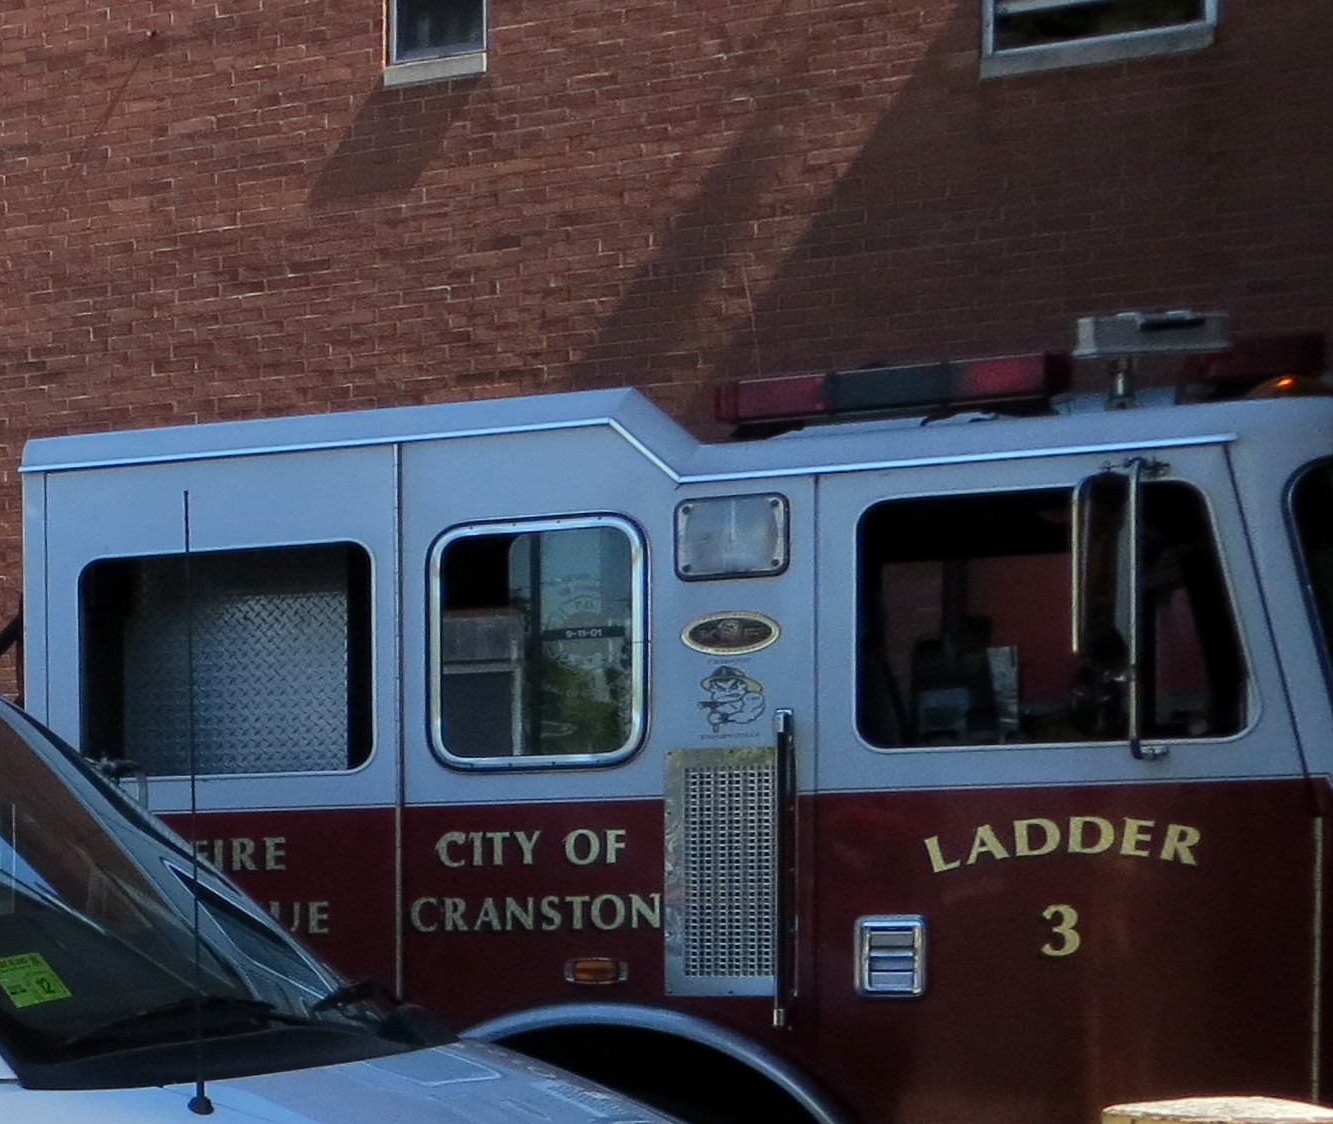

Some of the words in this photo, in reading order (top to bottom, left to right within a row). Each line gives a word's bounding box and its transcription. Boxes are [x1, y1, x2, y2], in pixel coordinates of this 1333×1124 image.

[435, 830, 541, 867] CITY
[564, 829, 626, 865] OF
[923, 815, 1202, 873] LADDER
[410, 893, 662, 932] CRANSTON
[1040, 904, 1082, 957] 3
